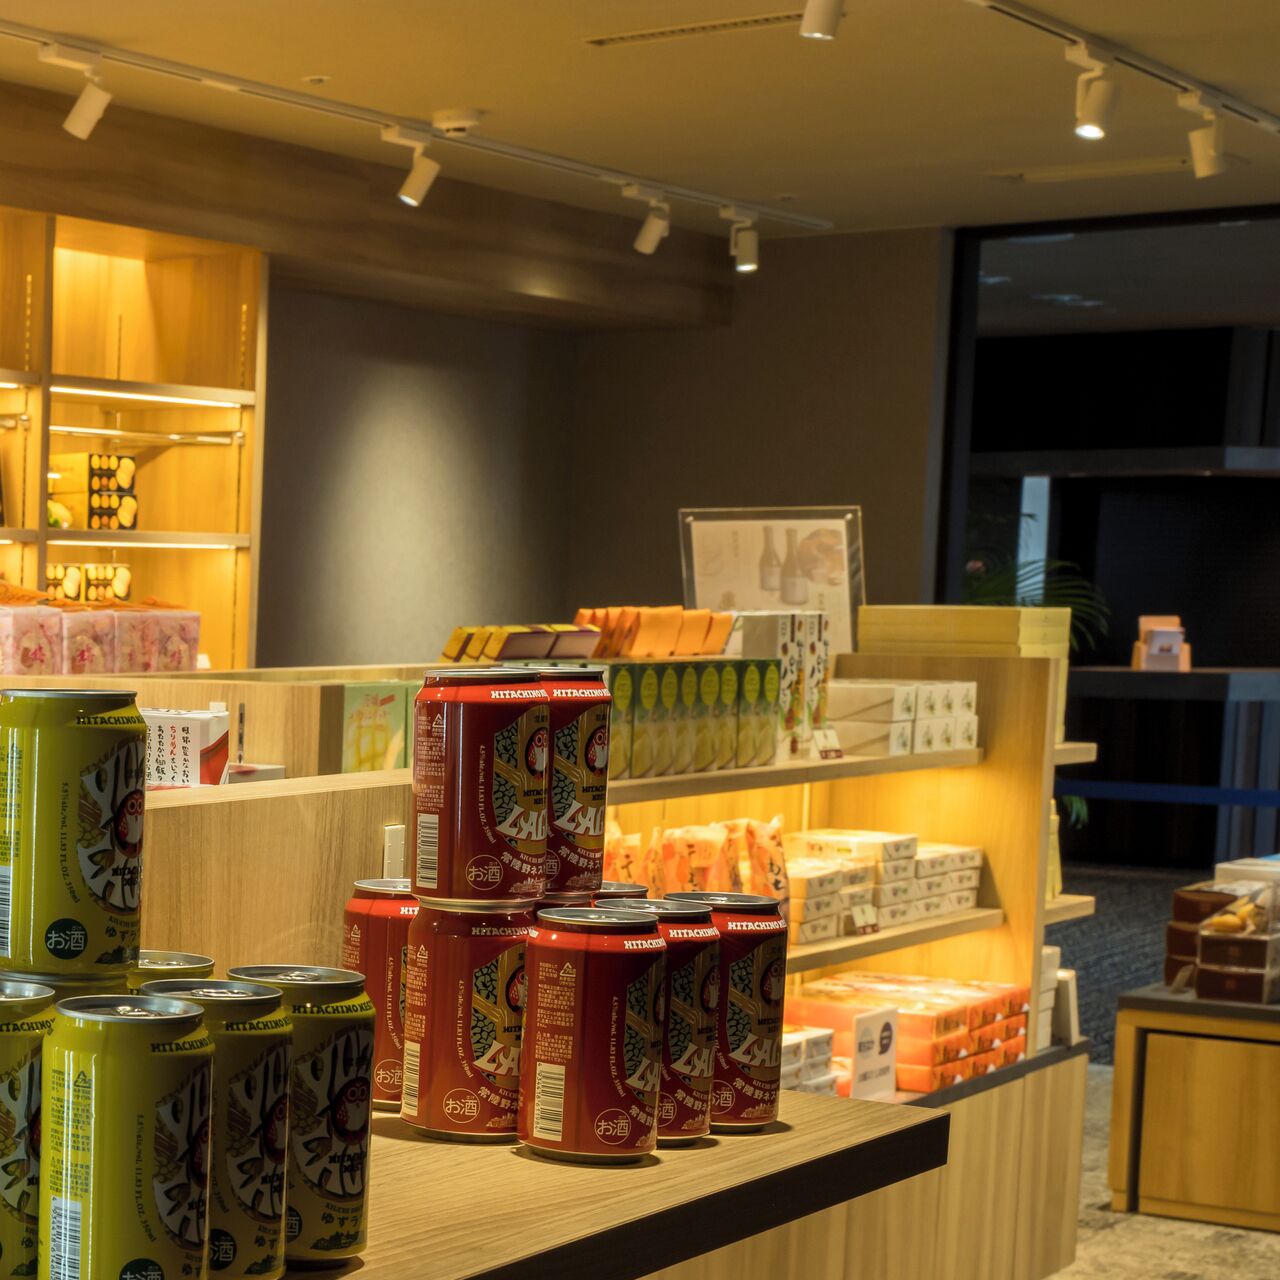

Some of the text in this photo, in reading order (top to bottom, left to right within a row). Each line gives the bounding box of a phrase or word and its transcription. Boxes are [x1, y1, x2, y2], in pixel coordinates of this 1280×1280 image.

[490, 690, 540, 700] HITACHINO
[496, 802, 547, 841] LAG
[553, 801, 604, 836] LAG
[467, 862, 501, 883] お酒
[46, 925, 85, 951] お酒
[445, 1095, 478, 1116] お酒
[597, 1115, 629, 1137] お酒
